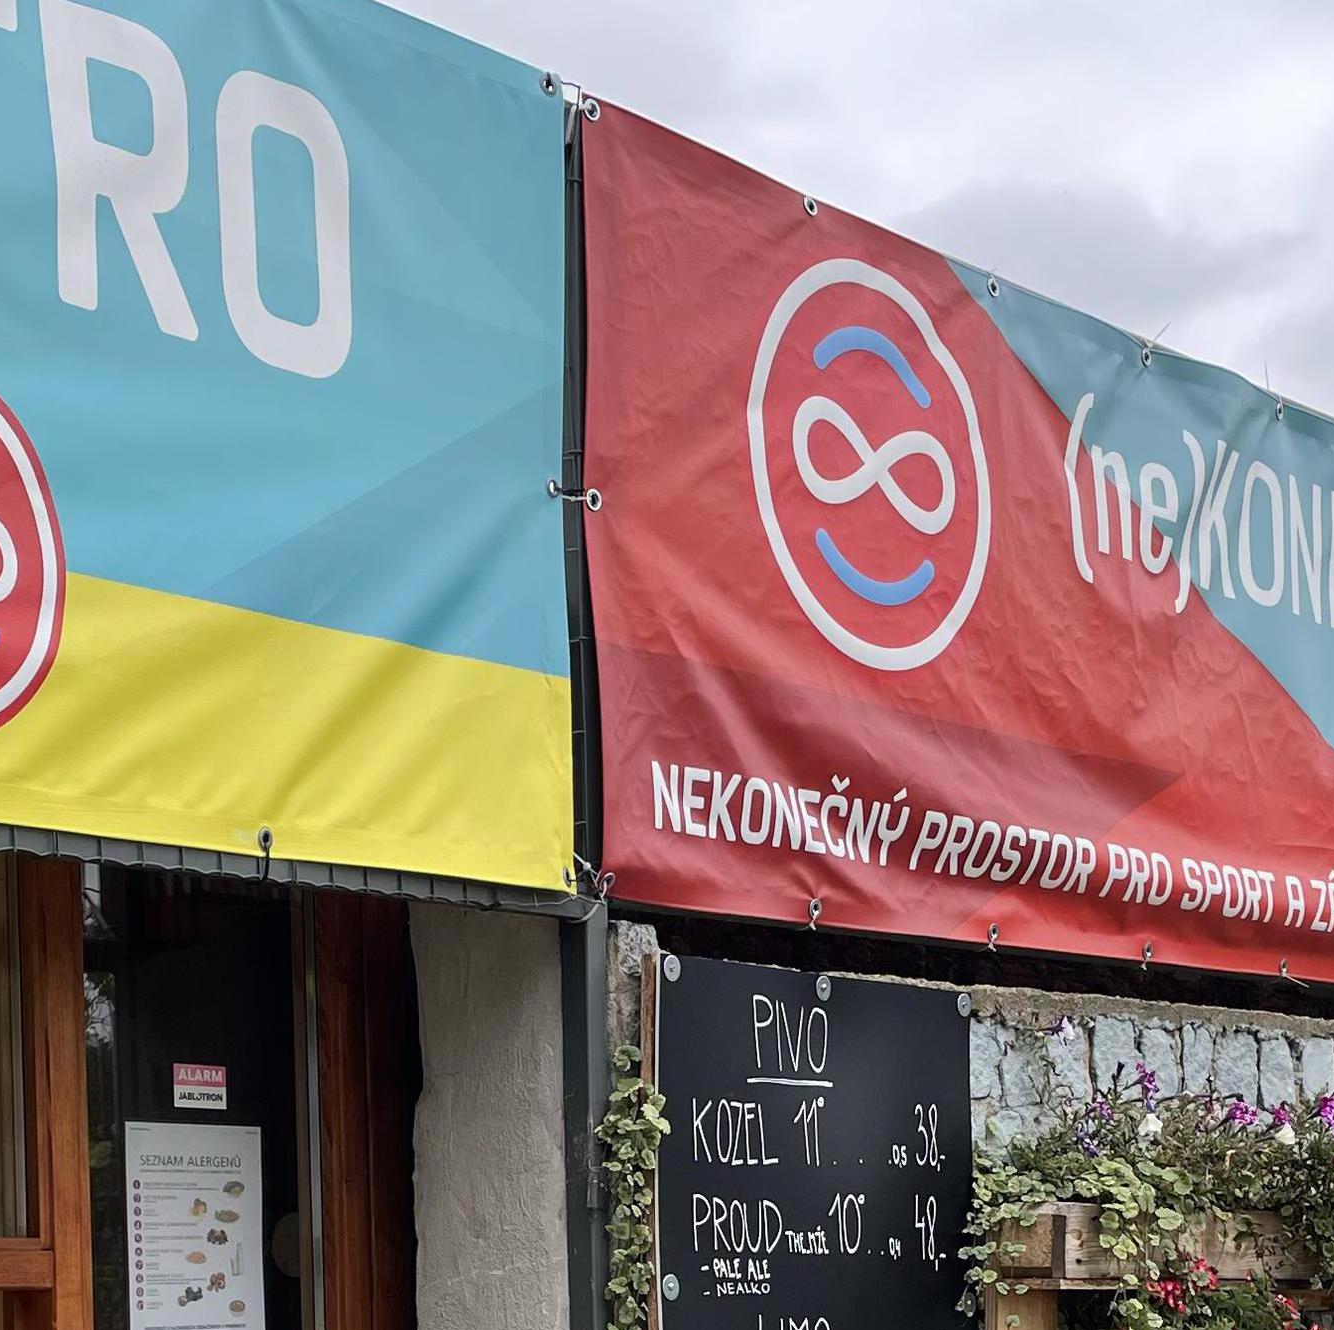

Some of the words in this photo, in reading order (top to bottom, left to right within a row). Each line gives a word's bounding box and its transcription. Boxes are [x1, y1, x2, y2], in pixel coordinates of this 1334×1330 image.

[651, 760, 911, 867] NEKONEČNÝ
[909, 810, 1097, 894] PROSTOR
[1098, 842, 1173, 907] PRO
[1180, 856, 1276, 924] SPORT
[1283, 874, 1306, 928] A
[752, 994, 829, 1074] PIVO
[178, 1068, 224, 1083] ALARM
[178, 1091, 224, 1103] JABLOTRON
[692, 1097, 779, 1167] KOZEL
[139, 1154, 184, 1167] SEZNAM
[186, 1154, 242, 1168] ALERGENŮ
[692, 1193, 783, 1254] PROUD
[713, 1257, 743, 1280] PALE
[747, 1258, 771, 1280] ALE
[717, 1282, 771, 1298] NEALKO
